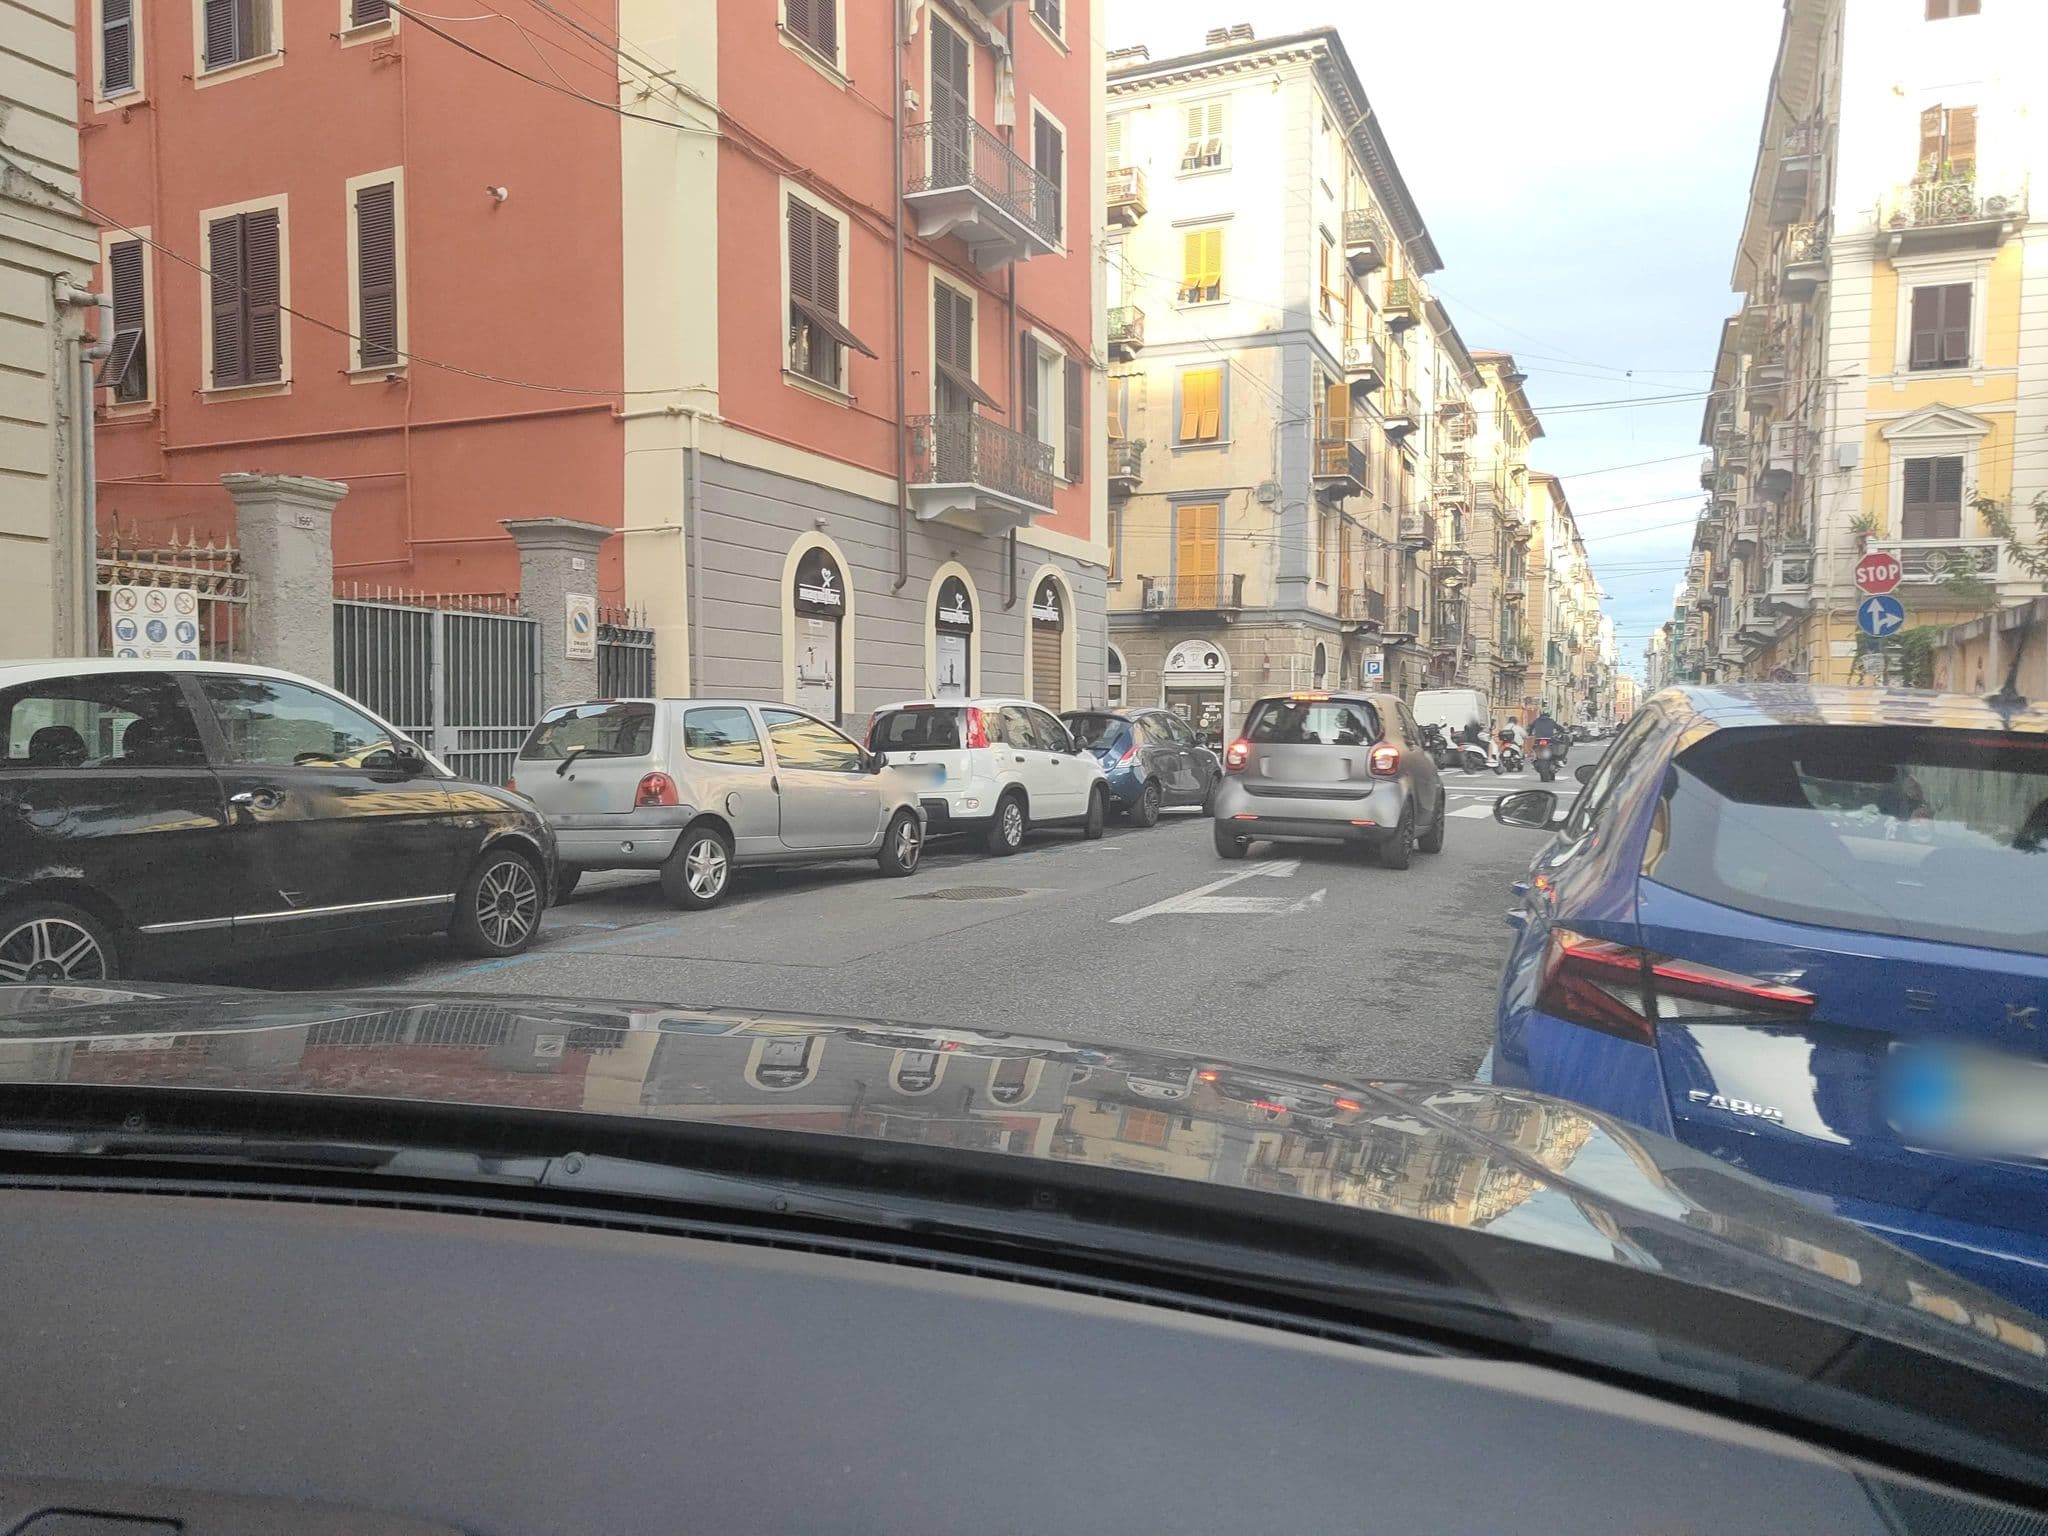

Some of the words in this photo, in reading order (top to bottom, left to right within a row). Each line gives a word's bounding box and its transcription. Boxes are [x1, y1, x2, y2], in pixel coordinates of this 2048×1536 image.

[1857, 564, 1899, 583] STOP
[1370, 663, 1378, 673] P
[1688, 1090, 1783, 1120] FABIA
